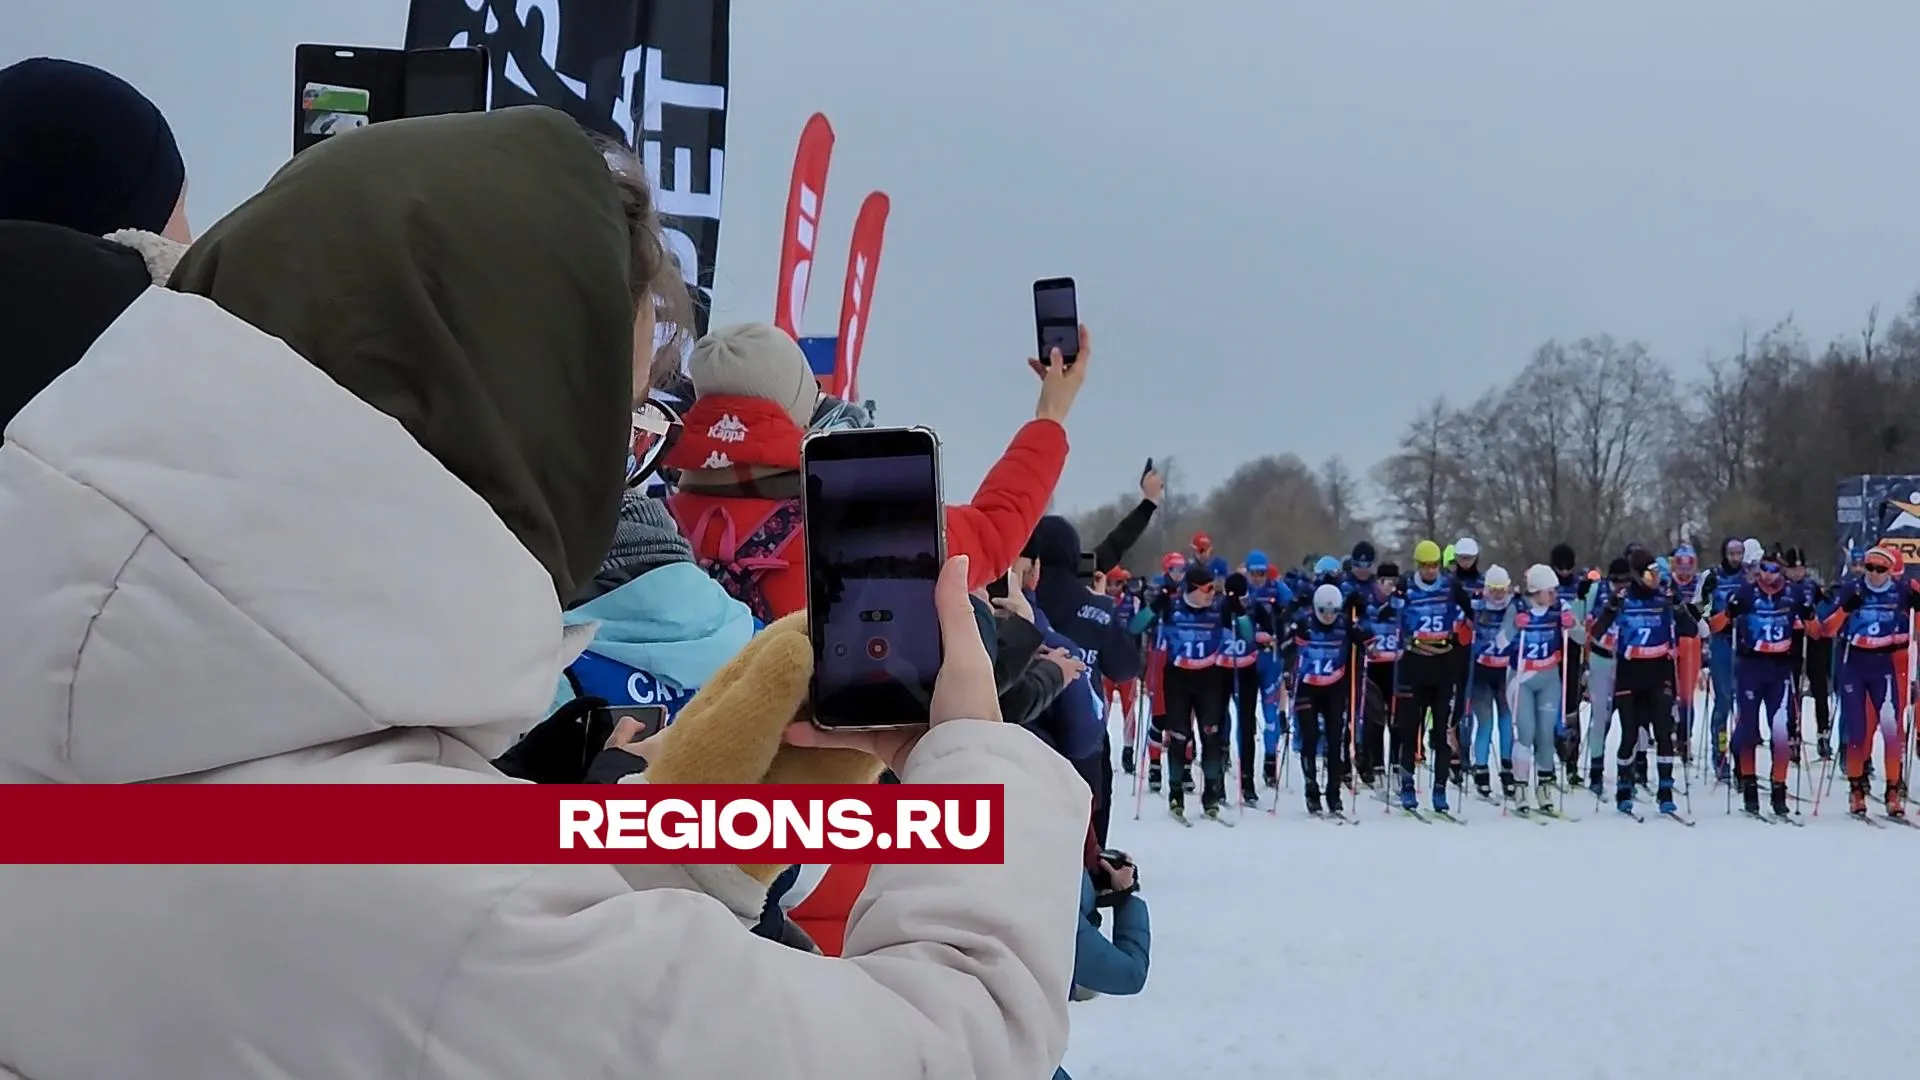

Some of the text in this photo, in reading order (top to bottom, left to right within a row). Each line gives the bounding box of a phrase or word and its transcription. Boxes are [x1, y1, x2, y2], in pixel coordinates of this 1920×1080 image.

[707, 426, 745, 443] Kappa
[1419, 615, 1443, 631] 25
[1638, 627, 1651, 645] 7
[1762, 624, 1784, 641] 13
[1184, 641, 1205, 657] 11
[1224, 639, 1246, 655] 20
[1376, 635, 1397, 650] 28
[1527, 643, 1548, 659] 21
[1312, 660, 1334, 674] 14
